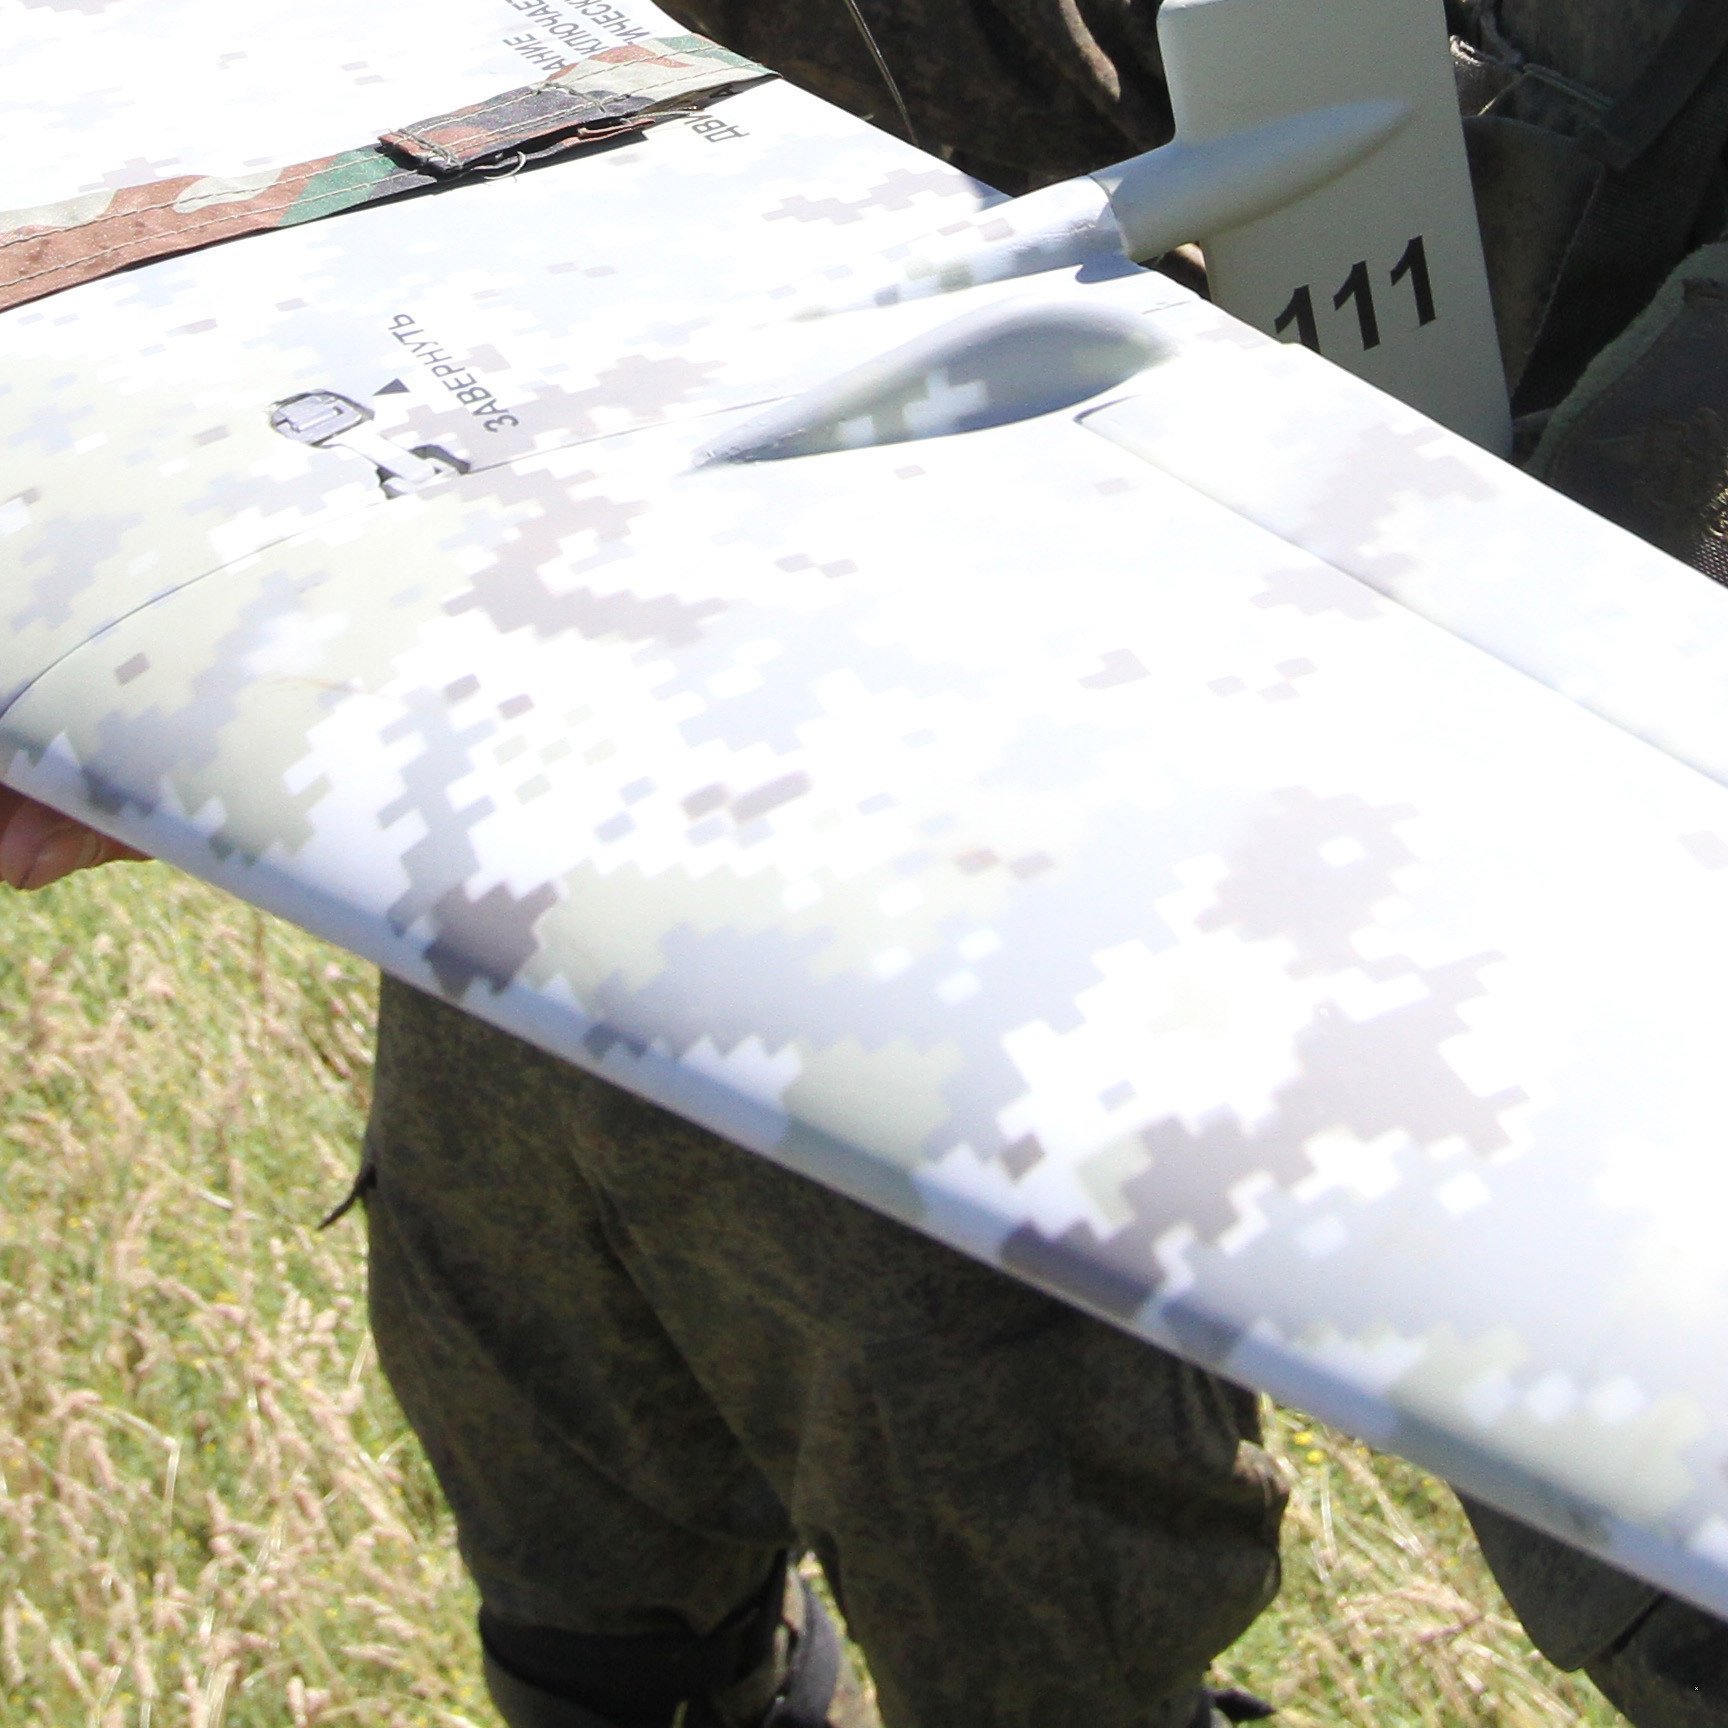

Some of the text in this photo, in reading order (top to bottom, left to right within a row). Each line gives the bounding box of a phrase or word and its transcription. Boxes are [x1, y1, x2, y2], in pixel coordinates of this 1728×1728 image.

[502, 33, 567, 71] АНИЕ
[1274, 234, 1437, 354] 111
[388, 313, 520, 433] ЗАВЕРНУТЬ
